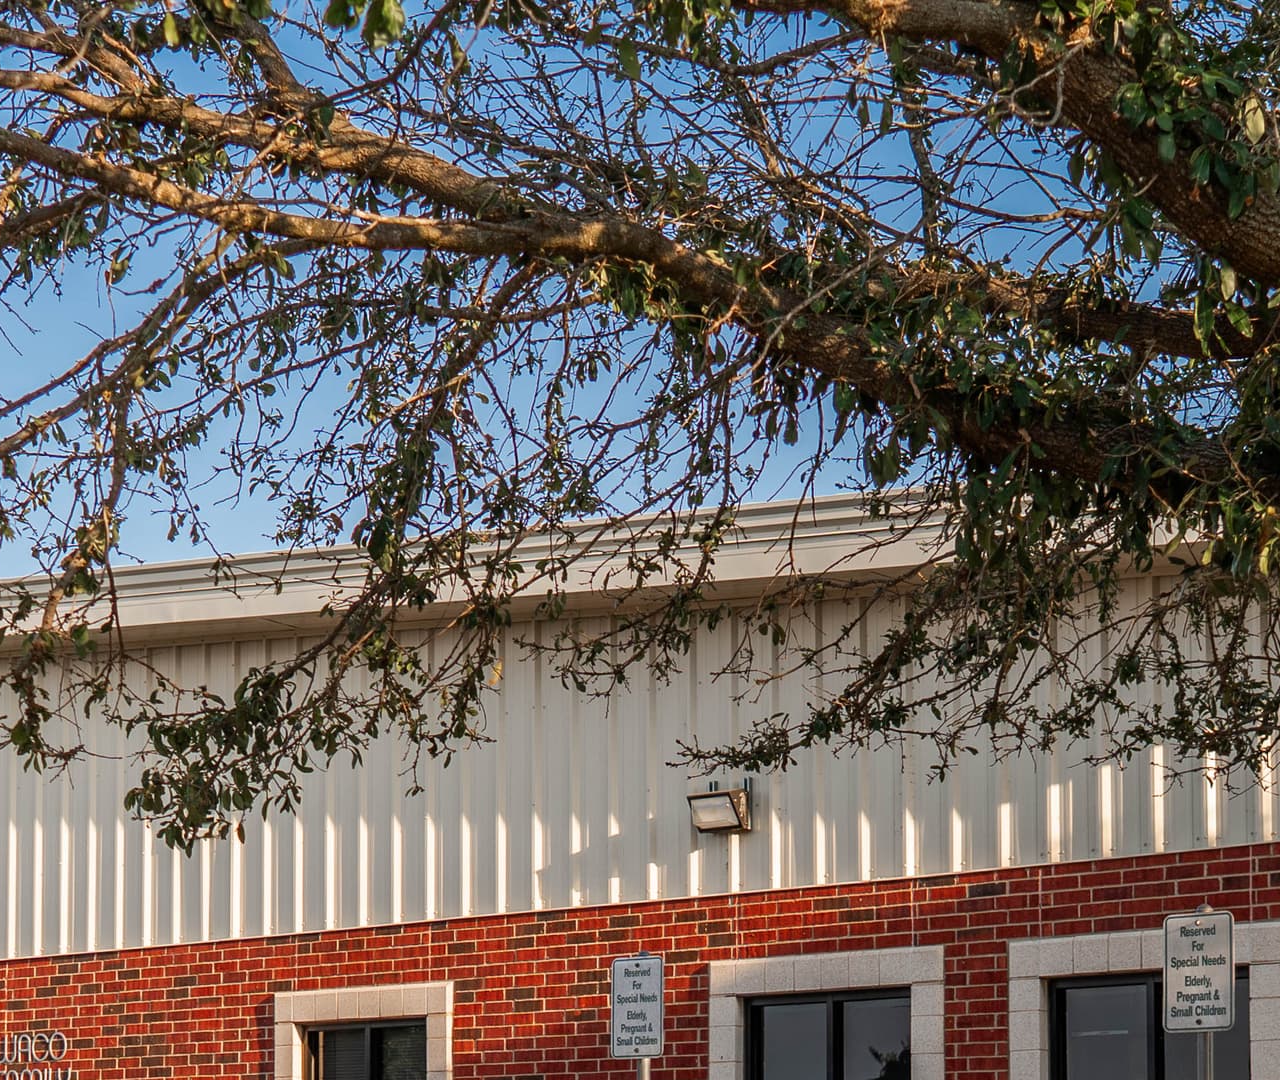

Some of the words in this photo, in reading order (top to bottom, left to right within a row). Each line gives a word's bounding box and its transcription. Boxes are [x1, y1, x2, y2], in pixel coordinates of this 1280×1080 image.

[1180, 924, 1216, 937] Reserved
[1192, 941, 1205, 951] For
[1171, 956, 1199, 970] Special
[1202, 955, 1226, 966] Needs
[624, 968, 651, 978] Reserved
[632, 981, 642, 990] For
[1185, 975, 1212, 988] Elderly,
[617, 994, 638, 1006] Special
[640, 993, 658, 1003] Needs
[1177, 990, 1211, 1004] Pregnant
[1214, 989, 1220, 1000] &
[627, 1010, 647, 1021] Elderly,
[1171, 1006, 1193, 1018] Small
[1195, 1004, 1227, 1016] Children
[621, 1023, 647, 1035] Pregnant
[648, 1023, 653, 1032] &
[617, 1036, 633, 1046] Small
[634, 1035, 658, 1046] Children
